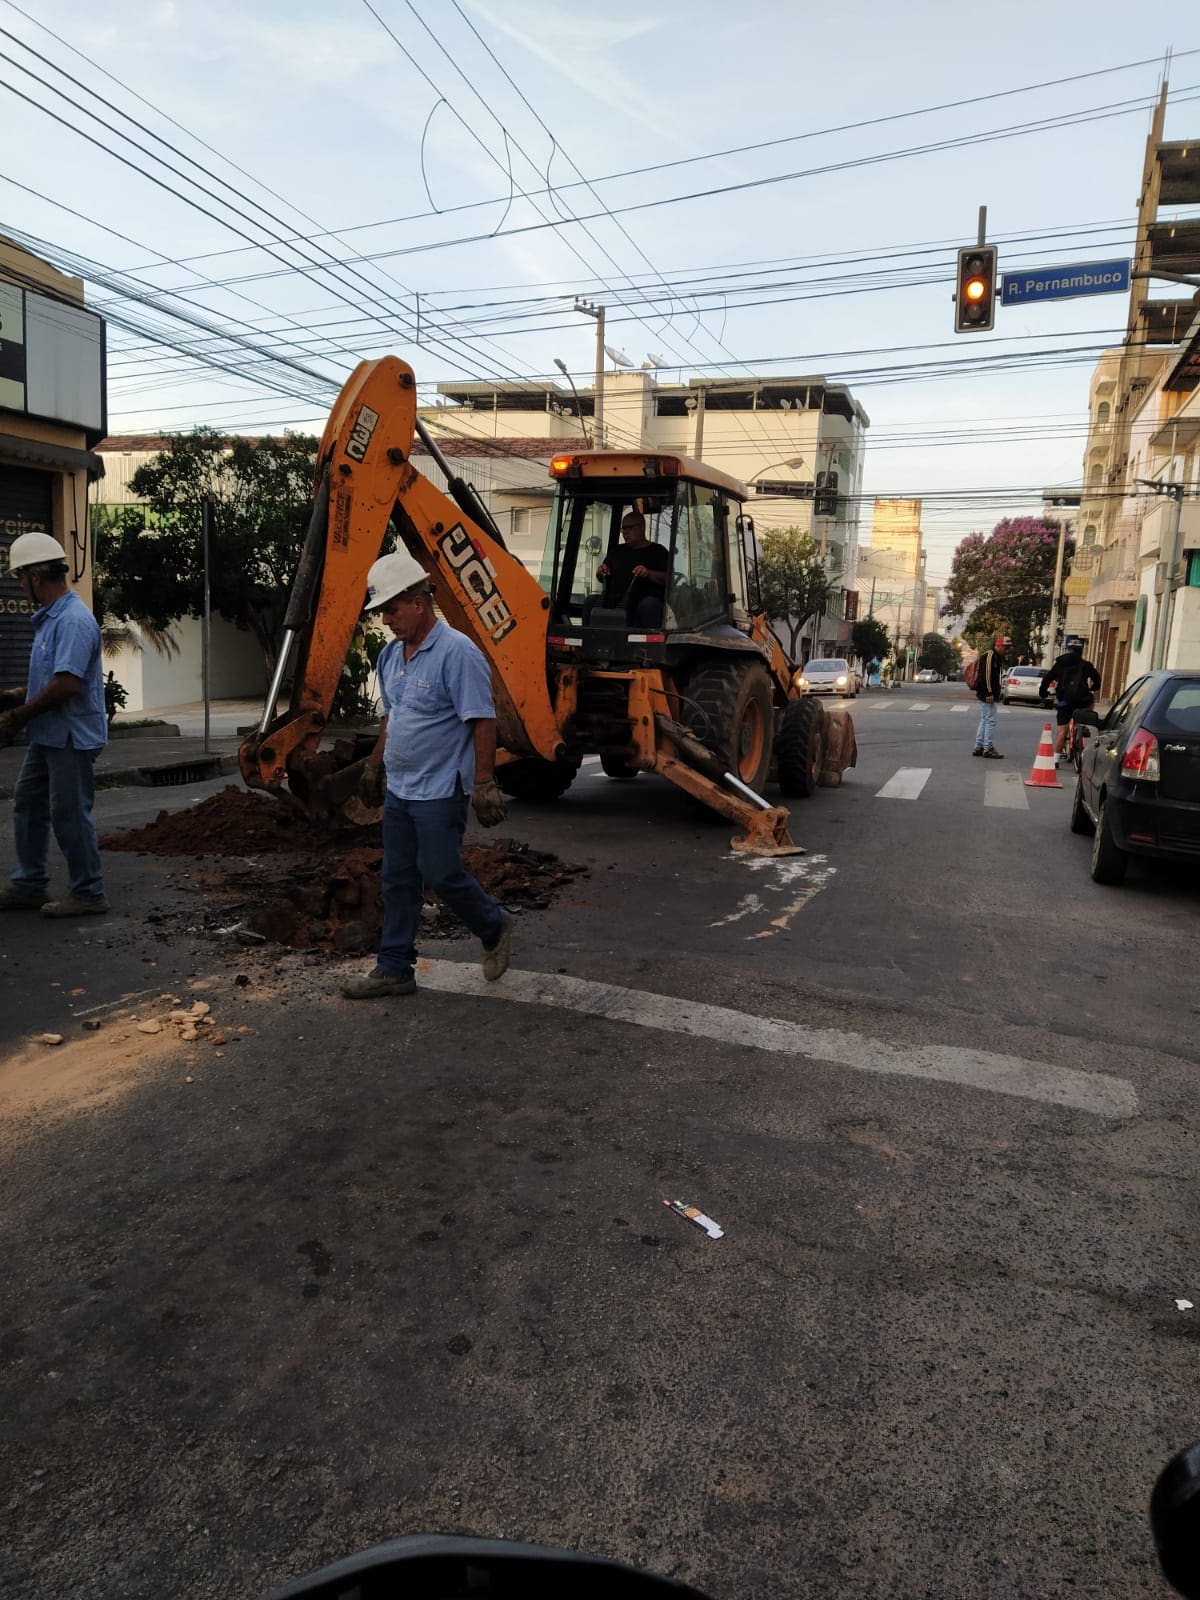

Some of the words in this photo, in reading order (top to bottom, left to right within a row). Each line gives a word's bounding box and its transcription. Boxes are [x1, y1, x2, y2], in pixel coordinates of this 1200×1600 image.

[1008, 282, 1022, 296] R.
[1026, 271, 1122, 294] Pernambuco
[439, 526, 515, 643] JCB
